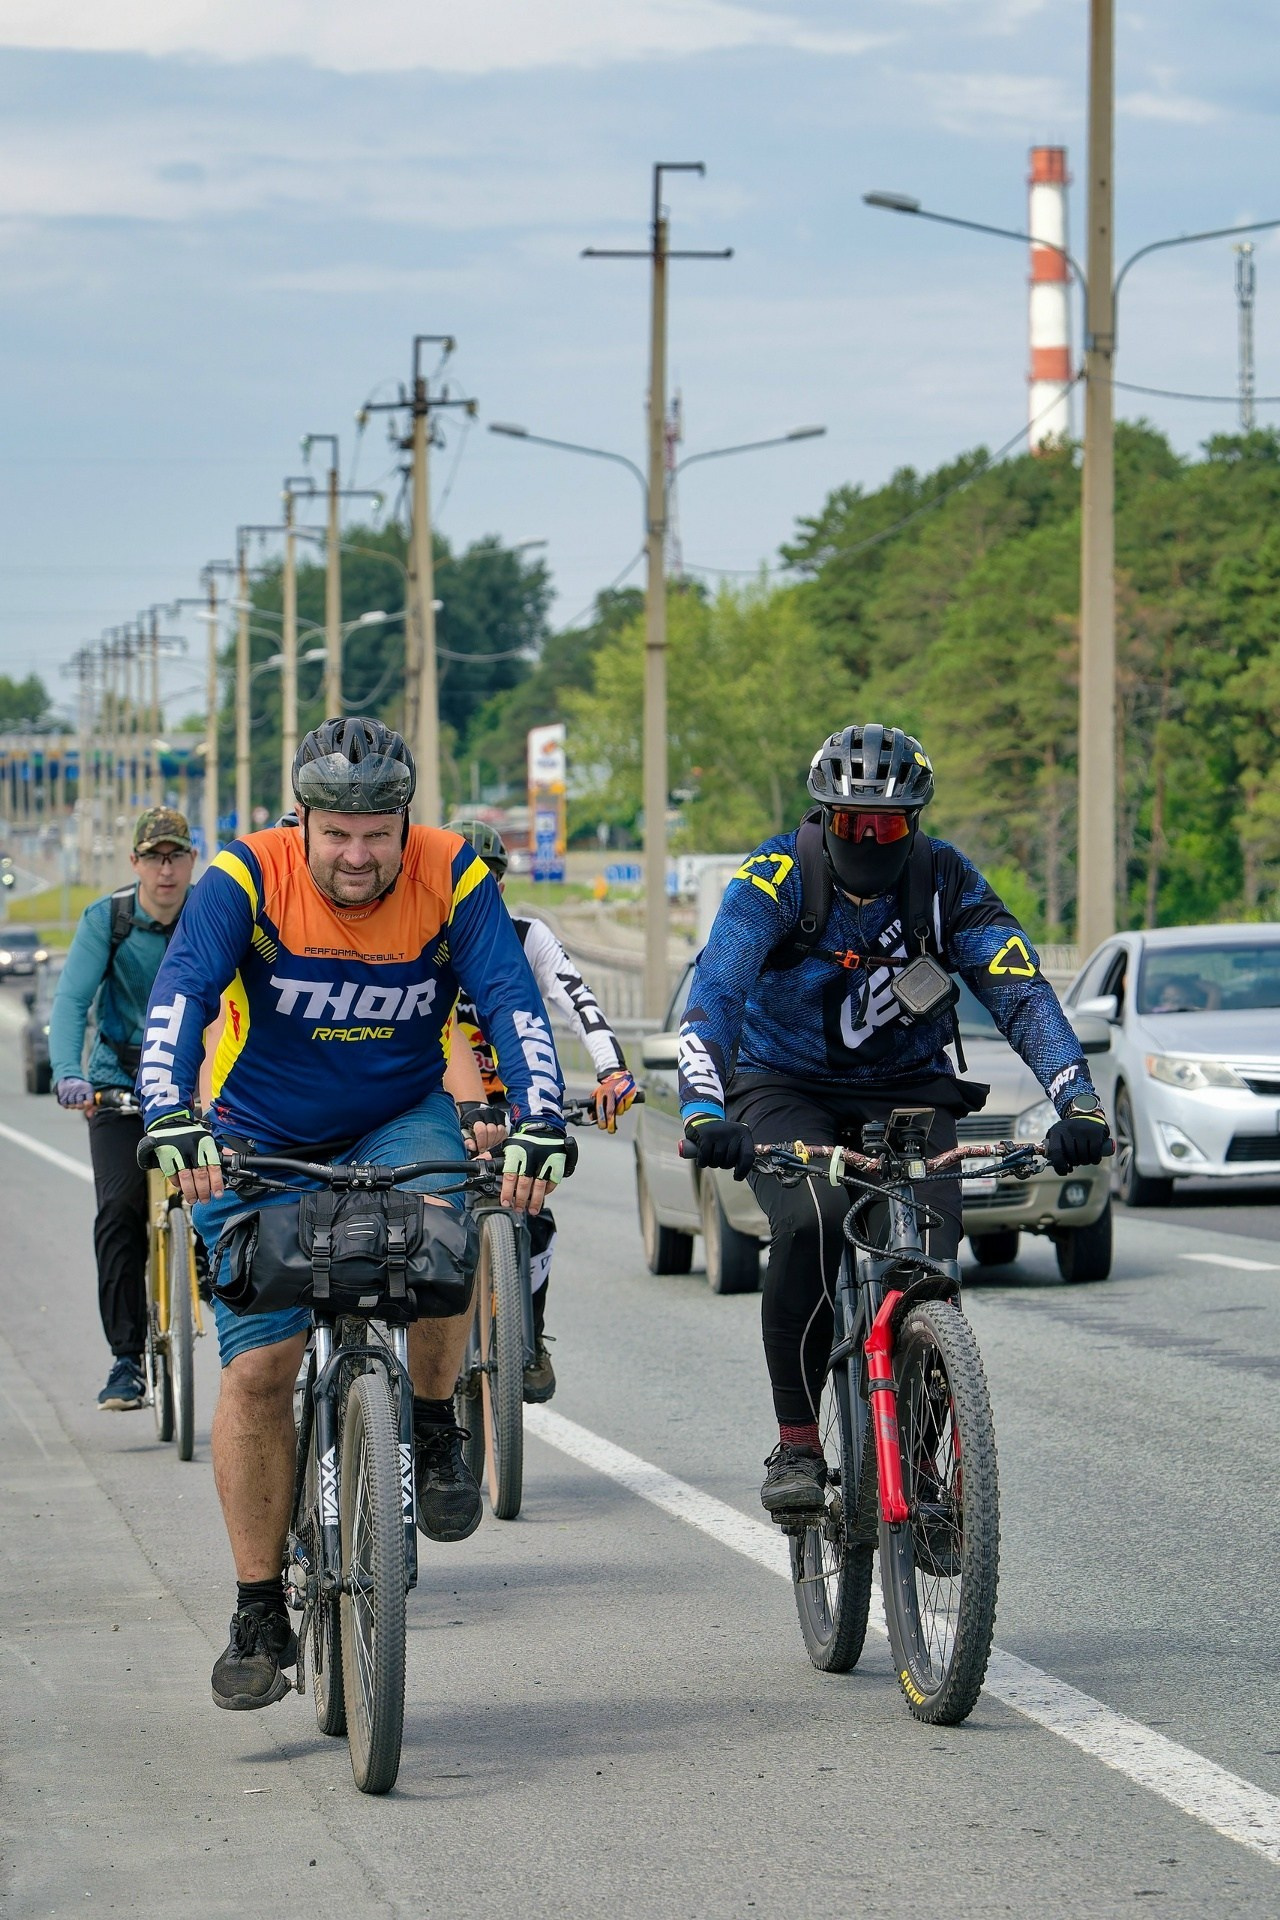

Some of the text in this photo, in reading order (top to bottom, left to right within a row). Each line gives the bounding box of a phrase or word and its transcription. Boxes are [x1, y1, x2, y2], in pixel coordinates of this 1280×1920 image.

[304, 946, 405, 961] PERFORMANCEBUILT
[270, 975, 437, 1020] THOR
[141, 993, 187, 1112] THOR
[311, 1026, 395, 1042] RACING
[512, 1009, 565, 1119] THOR
[321, 1445, 339, 1517] VAXA
[900, 1669, 926, 1705] MAXXIS
